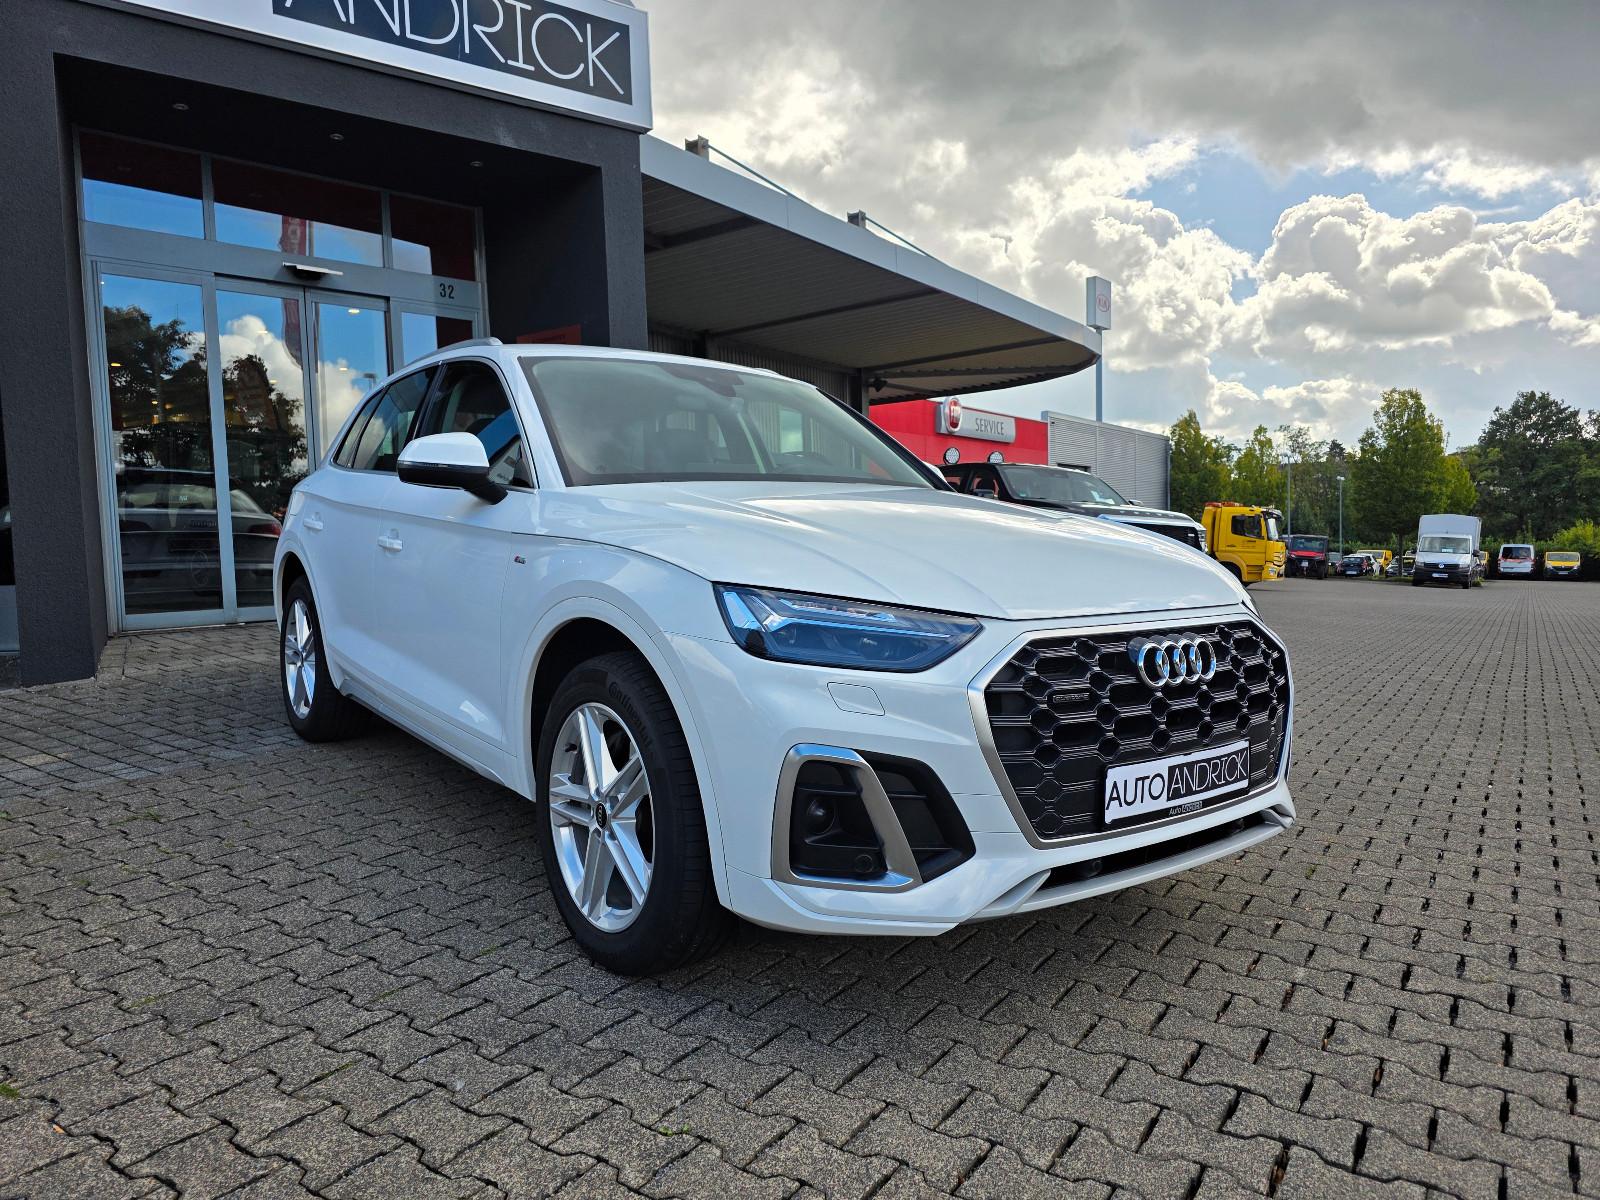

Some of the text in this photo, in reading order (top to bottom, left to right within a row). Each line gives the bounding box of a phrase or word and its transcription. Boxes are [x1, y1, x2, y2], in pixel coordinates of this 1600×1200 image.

[439, 282, 455, 300] 32
[975, 417, 1004, 436] SERVICE
[1105, 750, 1247, 811] AUTO ANDRICK
